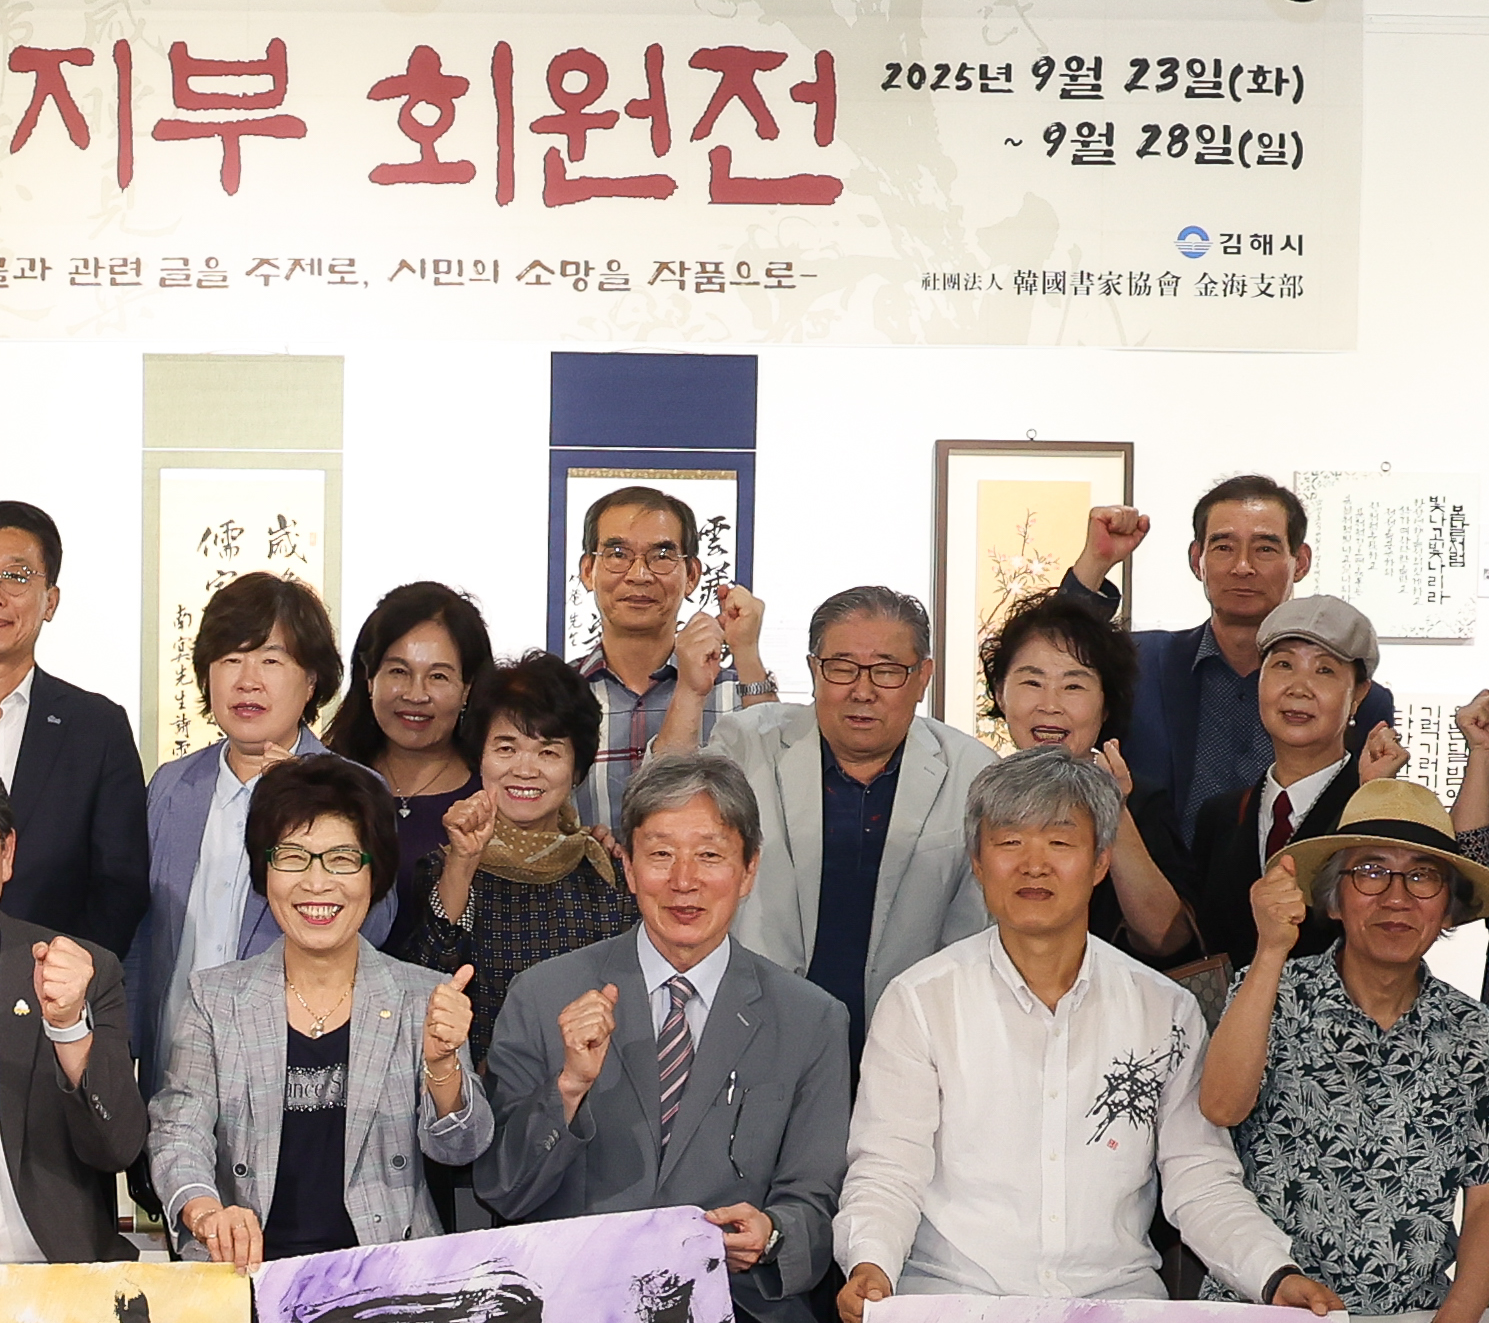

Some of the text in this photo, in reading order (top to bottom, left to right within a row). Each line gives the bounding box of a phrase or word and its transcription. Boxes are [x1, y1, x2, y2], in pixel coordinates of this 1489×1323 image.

[881, 55, 1304, 105] 2025년 9월 23일(화)
[367, 41, 843, 208] 회원전
[1043, 121, 1116, 166] 9월
[1135, 123, 1304, 170] 28일(일)
[1219, 233, 1303, 256] 김해시
[68, 257, 142, 287] 관련
[159, 256, 228, 289] 글을
[245, 258, 368, 289] 주제로,
[389, 258, 499, 286] 시민의
[515, 259, 631, 292] 소망을
[1013, 269, 1181, 297] 韓國書家協會
[1193, 272, 1304, 299] 金海支部
